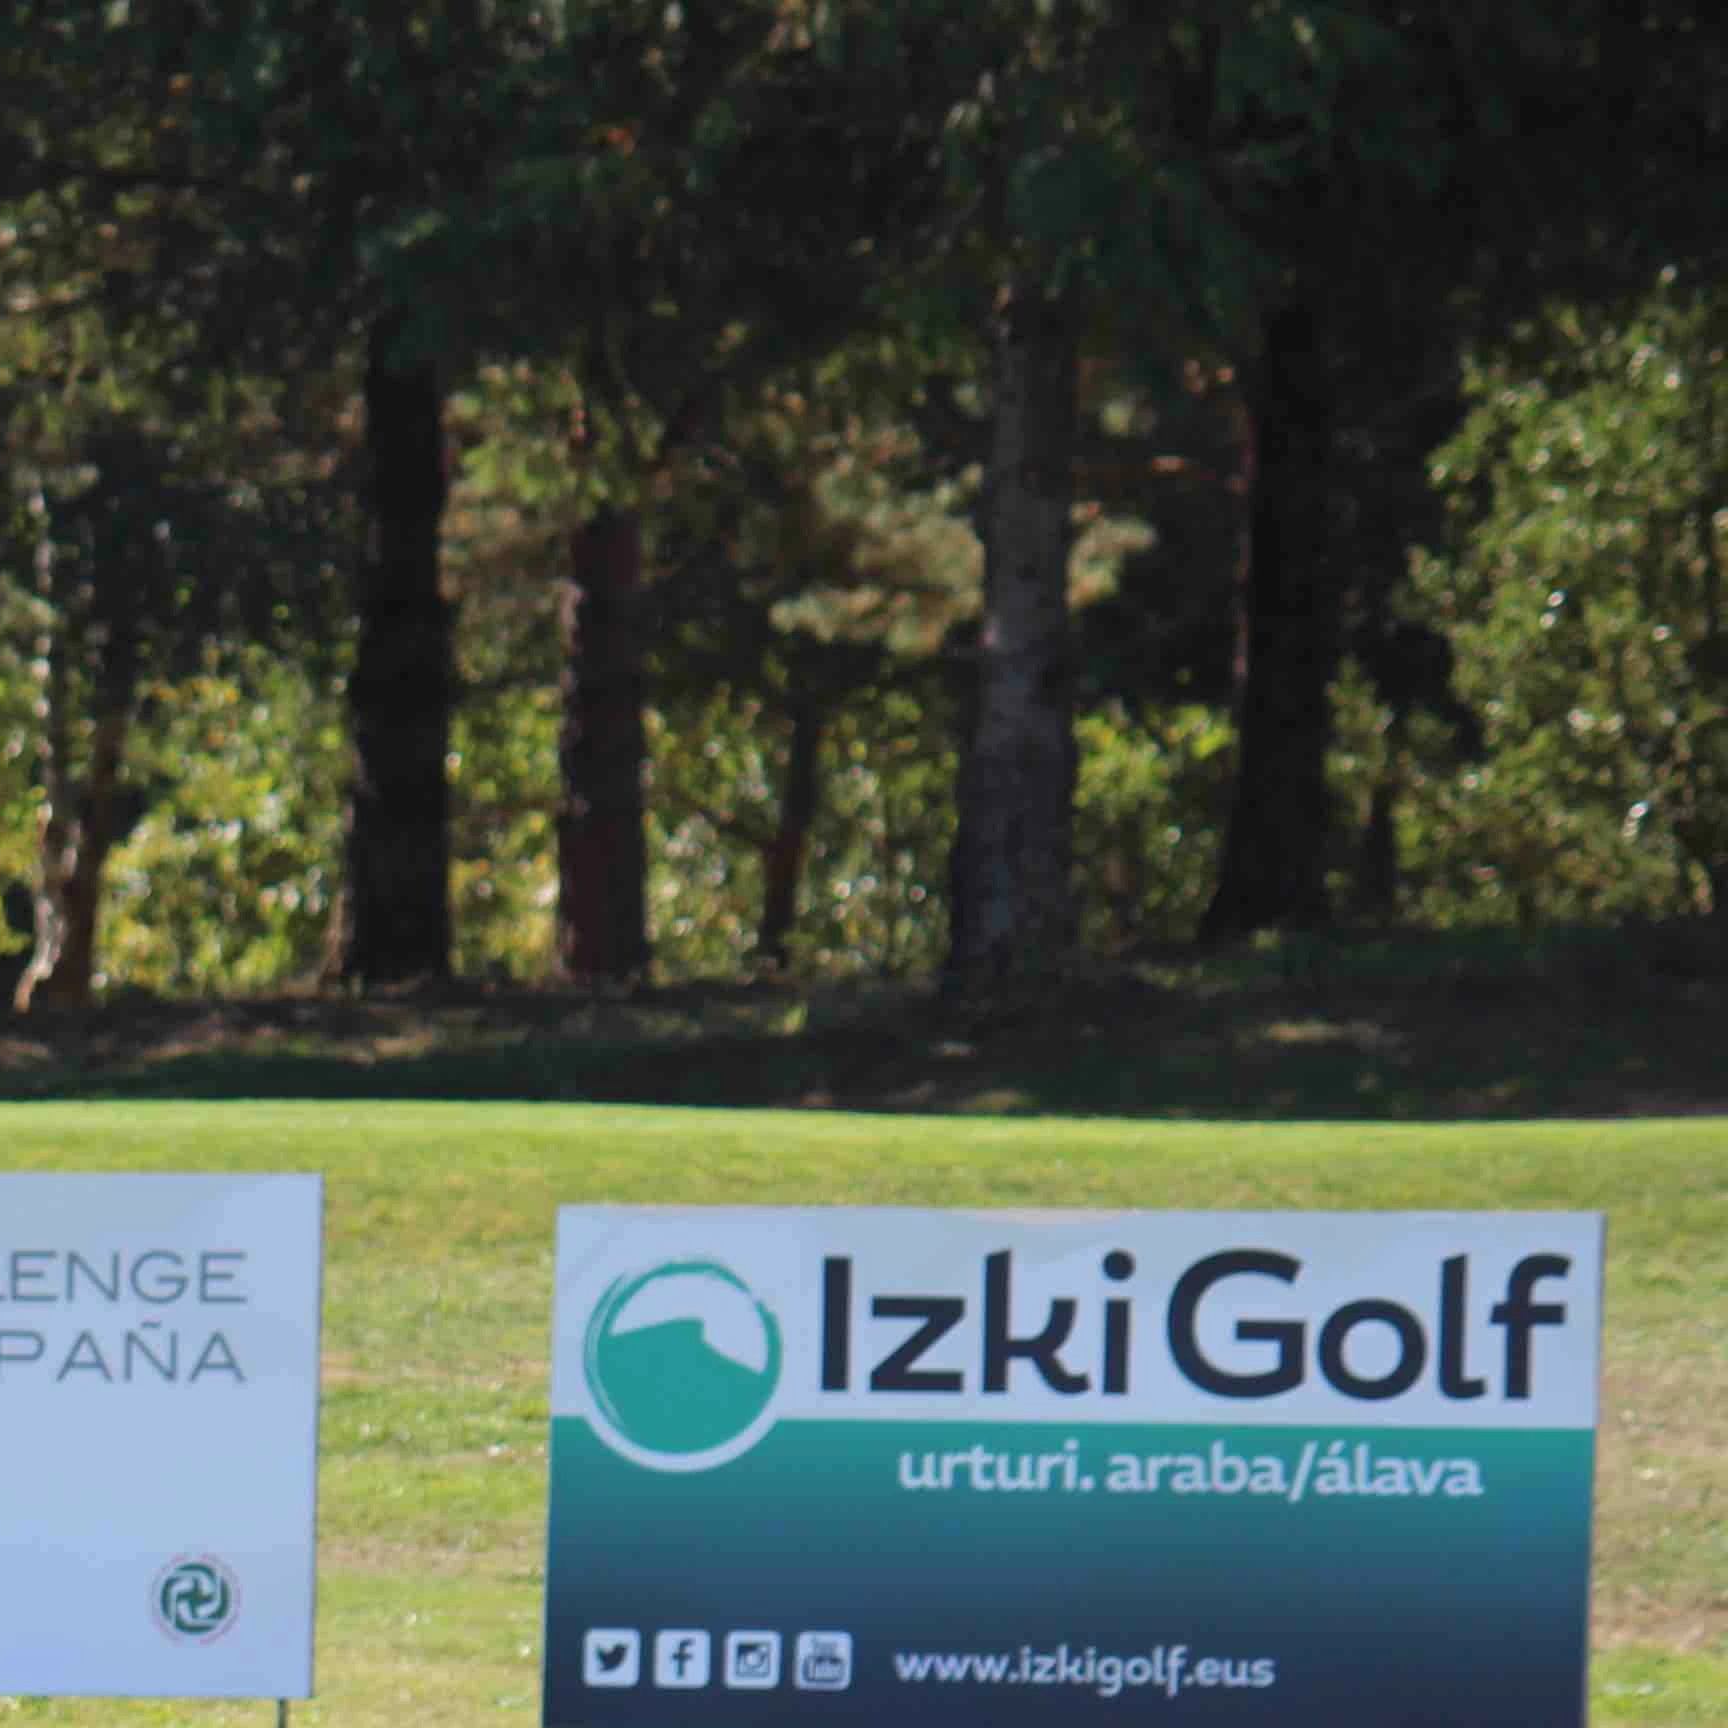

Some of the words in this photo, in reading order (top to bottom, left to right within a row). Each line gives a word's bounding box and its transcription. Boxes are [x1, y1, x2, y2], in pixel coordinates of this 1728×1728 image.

[898, 1436, 1096, 1493] urturi.
[1105, 1438, 1484, 1502] araba/álava
[894, 1643, 1276, 1697] www.izkigolf.eus
